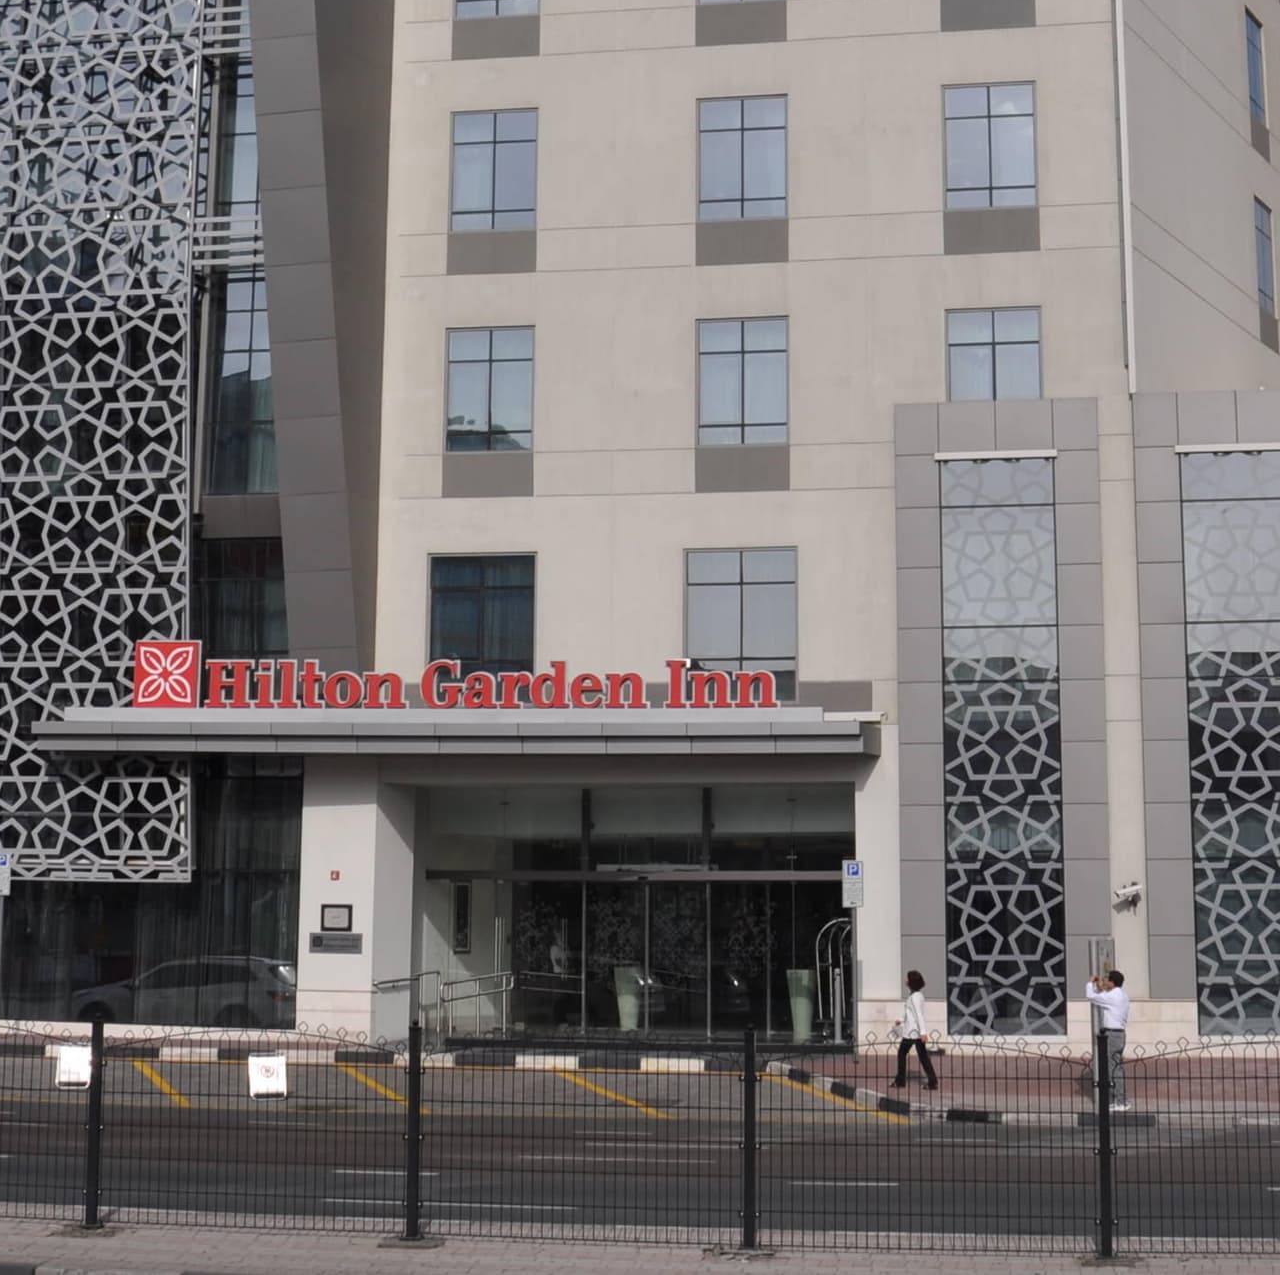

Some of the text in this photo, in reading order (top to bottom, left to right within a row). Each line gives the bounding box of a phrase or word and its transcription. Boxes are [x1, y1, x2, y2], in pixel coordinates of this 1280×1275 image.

[204, 658, 780, 709] Hilton Garden Inn
